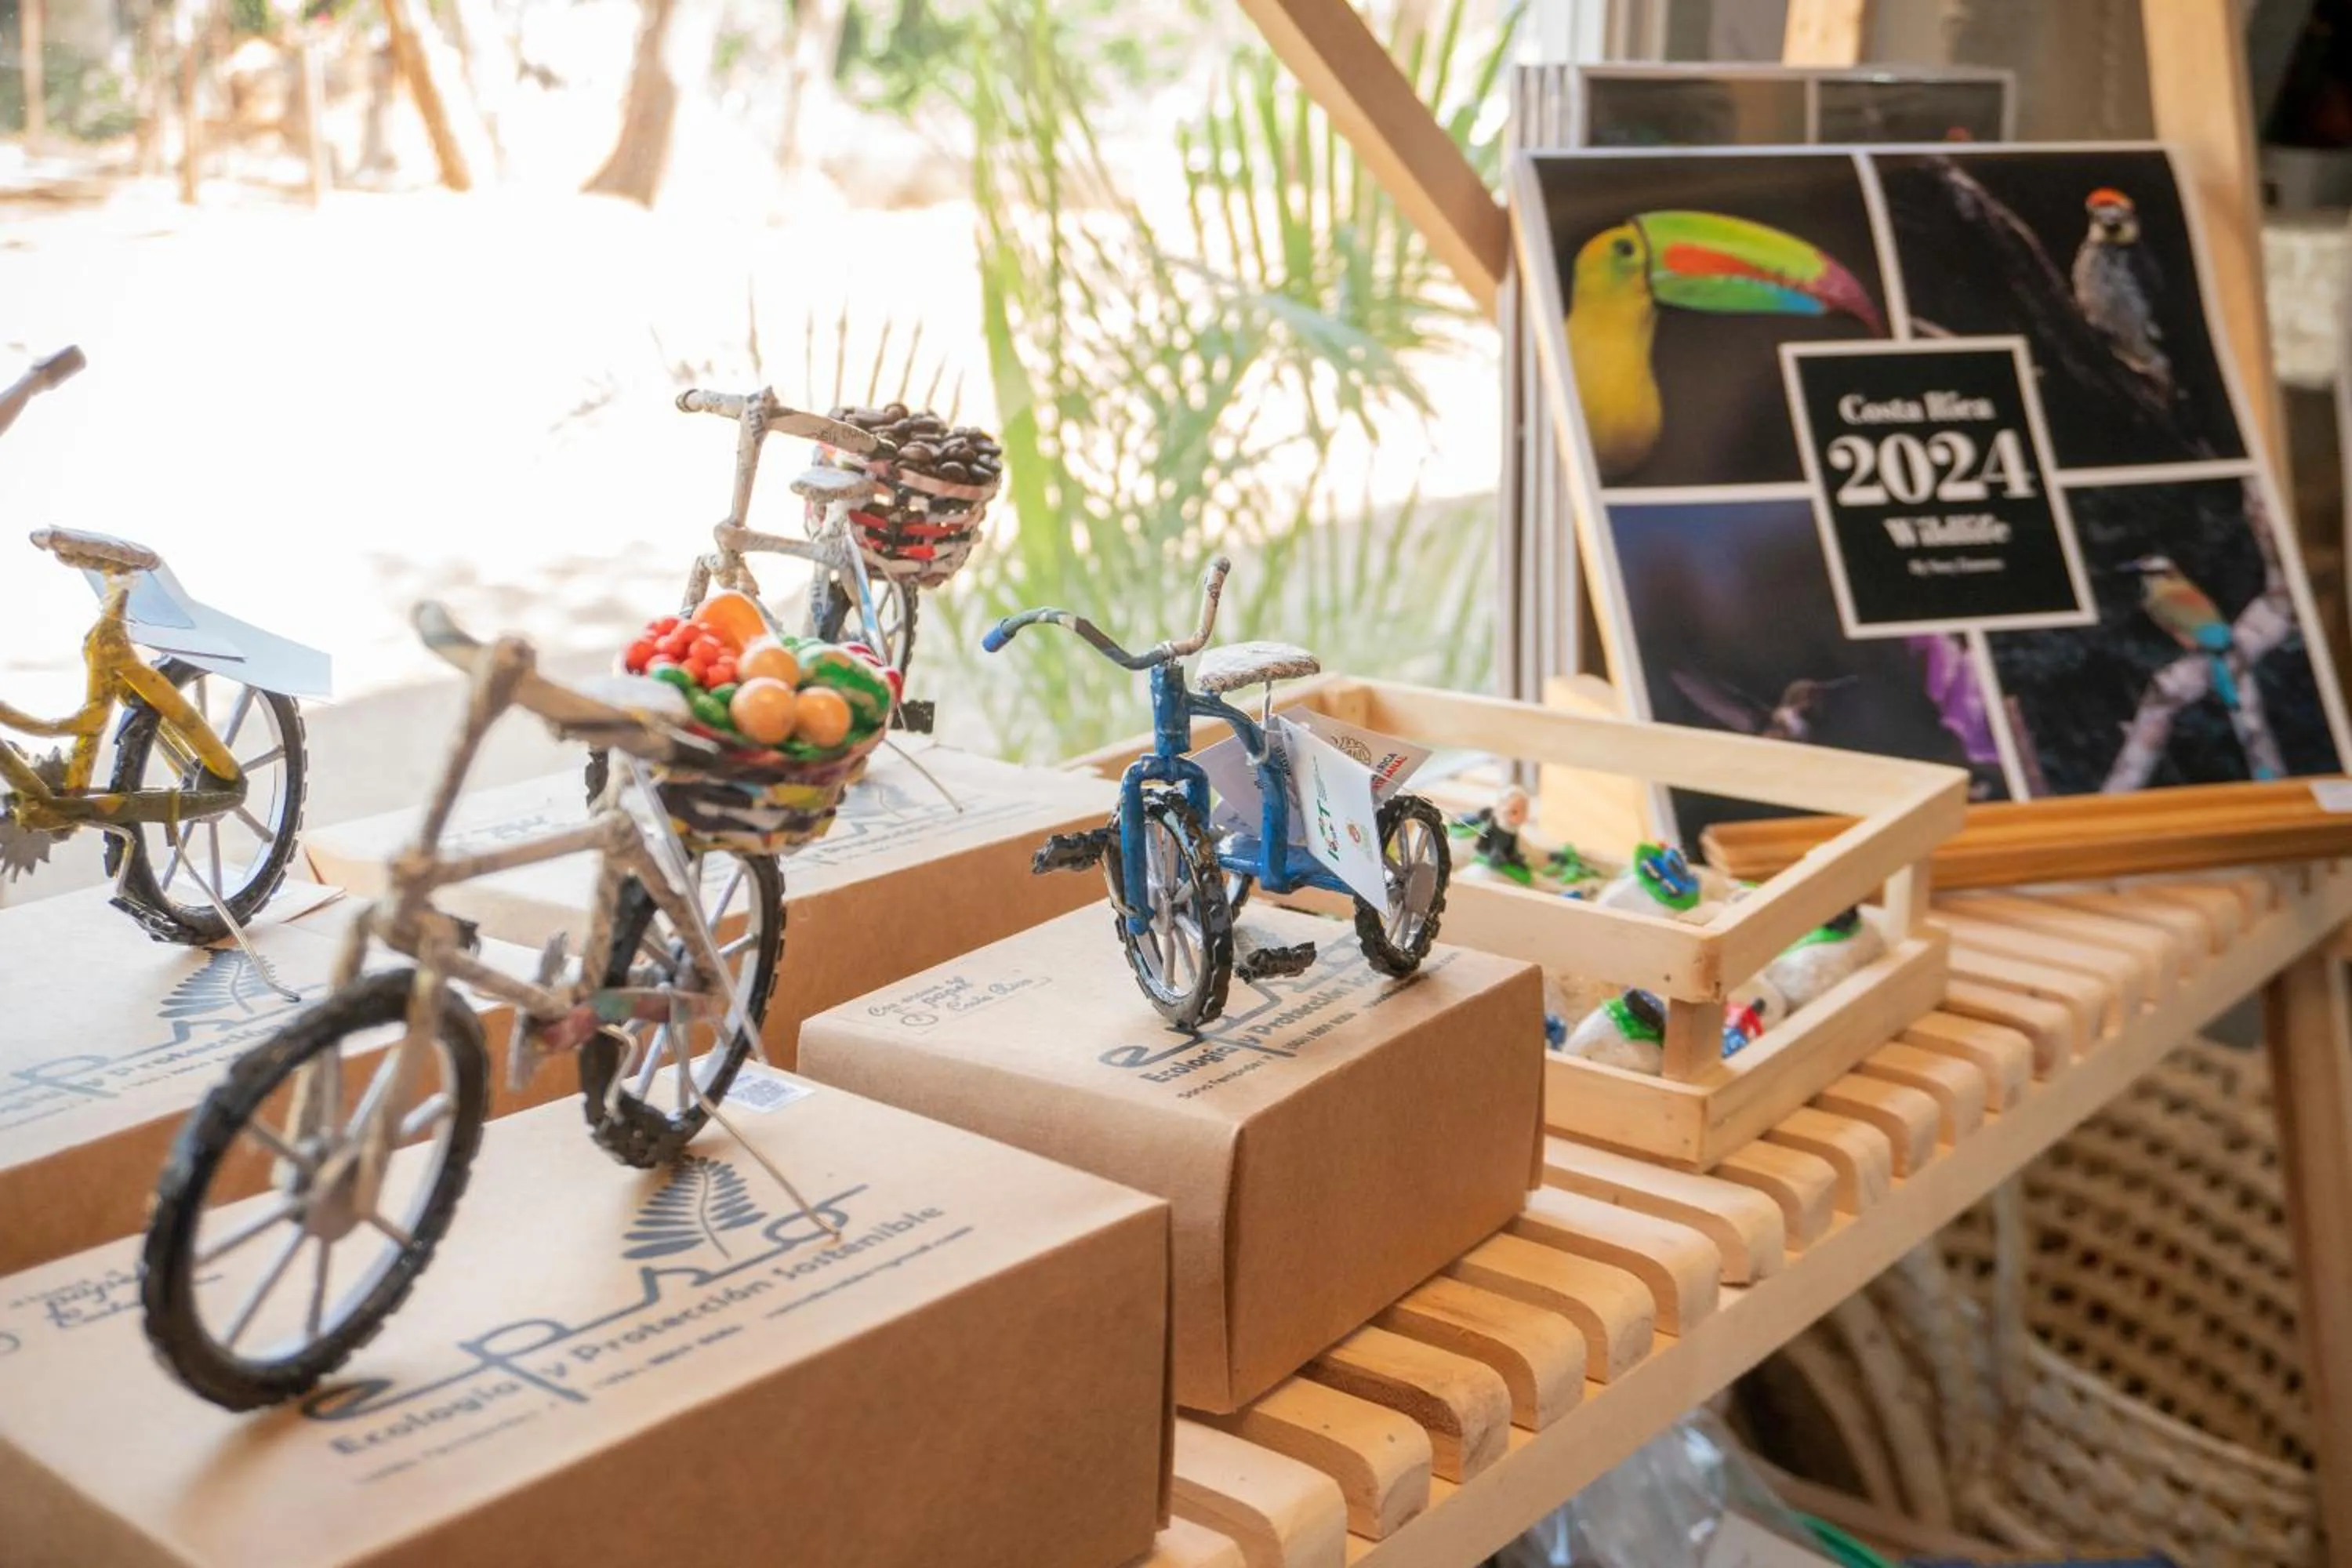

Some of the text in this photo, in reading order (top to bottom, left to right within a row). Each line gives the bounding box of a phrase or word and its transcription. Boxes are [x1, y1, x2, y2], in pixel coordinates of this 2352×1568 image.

[1838, 390, 1997, 426] Costa Rica
[1826, 427, 2038, 508] 2024
[1882, 514, 2012, 550] Wildlife
